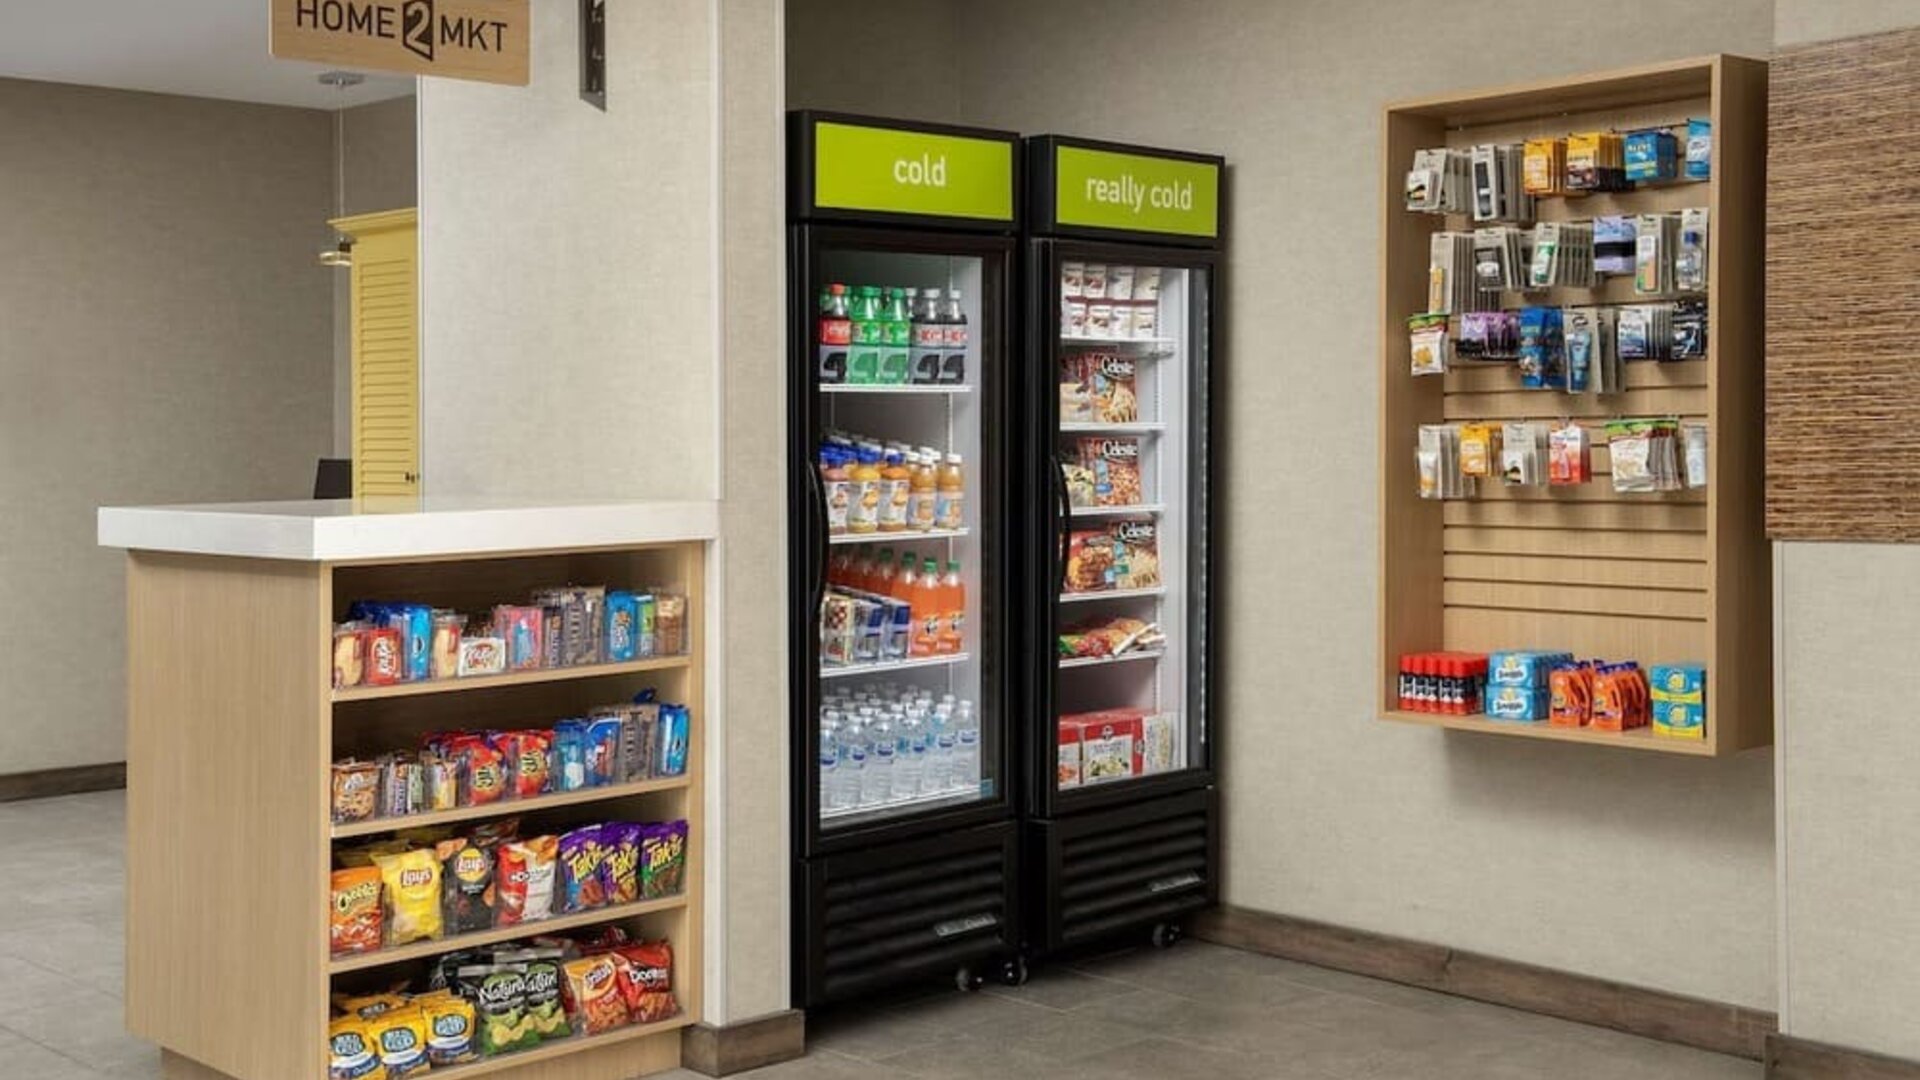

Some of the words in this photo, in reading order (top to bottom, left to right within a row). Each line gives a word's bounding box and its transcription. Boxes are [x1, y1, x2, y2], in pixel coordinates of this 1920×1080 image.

[894, 153, 947, 187] cold
[1086, 174, 1145, 214] really
[1150, 182, 1192, 211] cold
